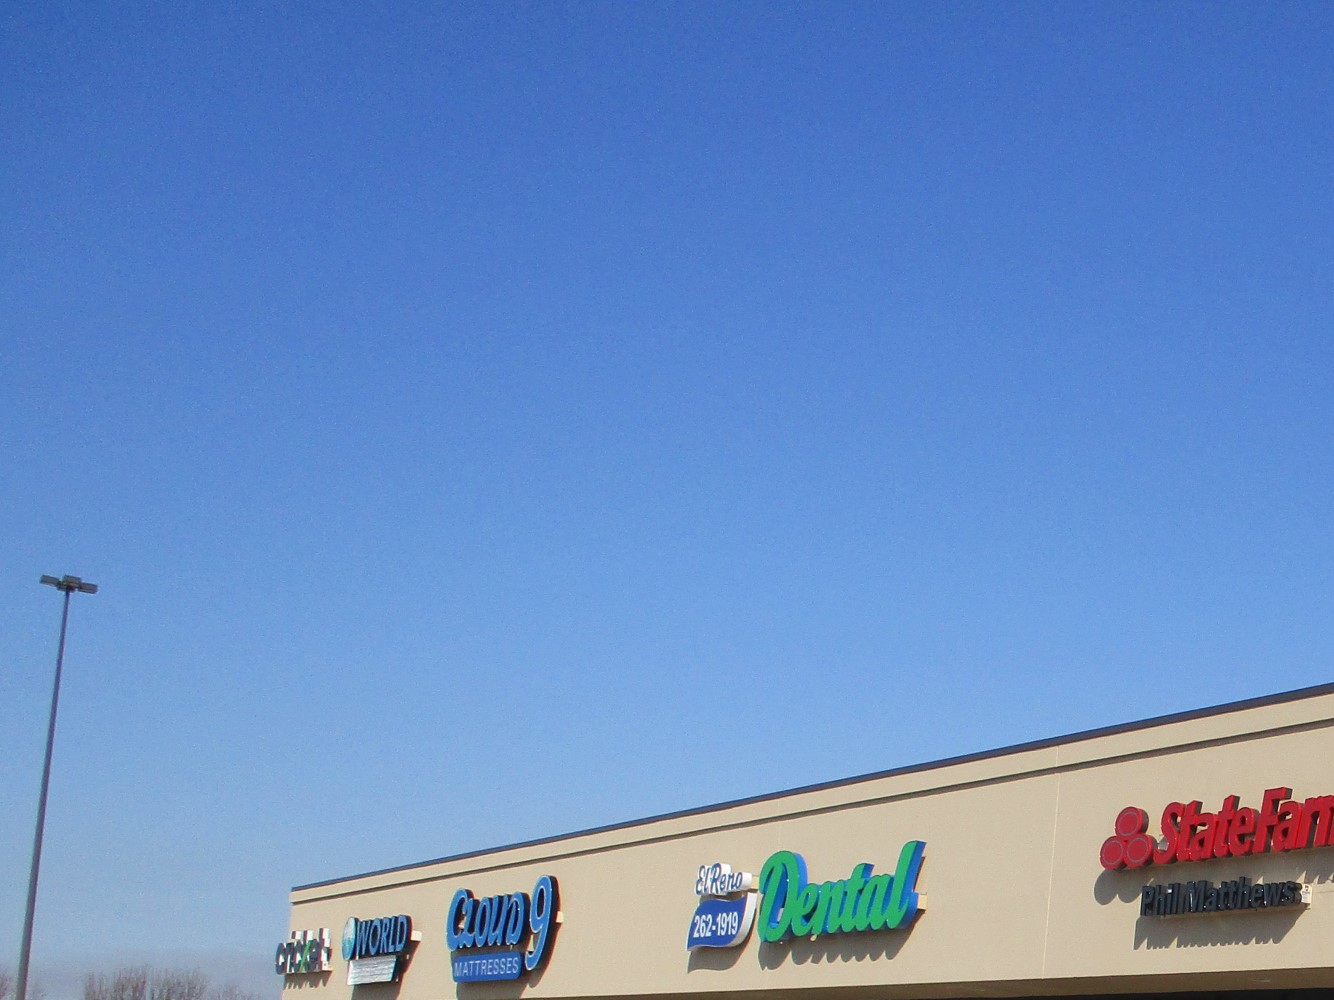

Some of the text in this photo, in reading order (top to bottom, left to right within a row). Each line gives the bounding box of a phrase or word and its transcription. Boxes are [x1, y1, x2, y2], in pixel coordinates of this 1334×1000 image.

[694, 862, 745, 895] El Reno
[757, 840, 926, 943] Dental
[1140, 882, 1184, 917] Phil
[1187, 876, 1302, 913] Matthews
[355, 914, 409, 956] WORLD
[525, 875, 554, 971] 9
[692, 910, 739, 938] 262-1919
[454, 956, 519, 977] MATTRESSES
